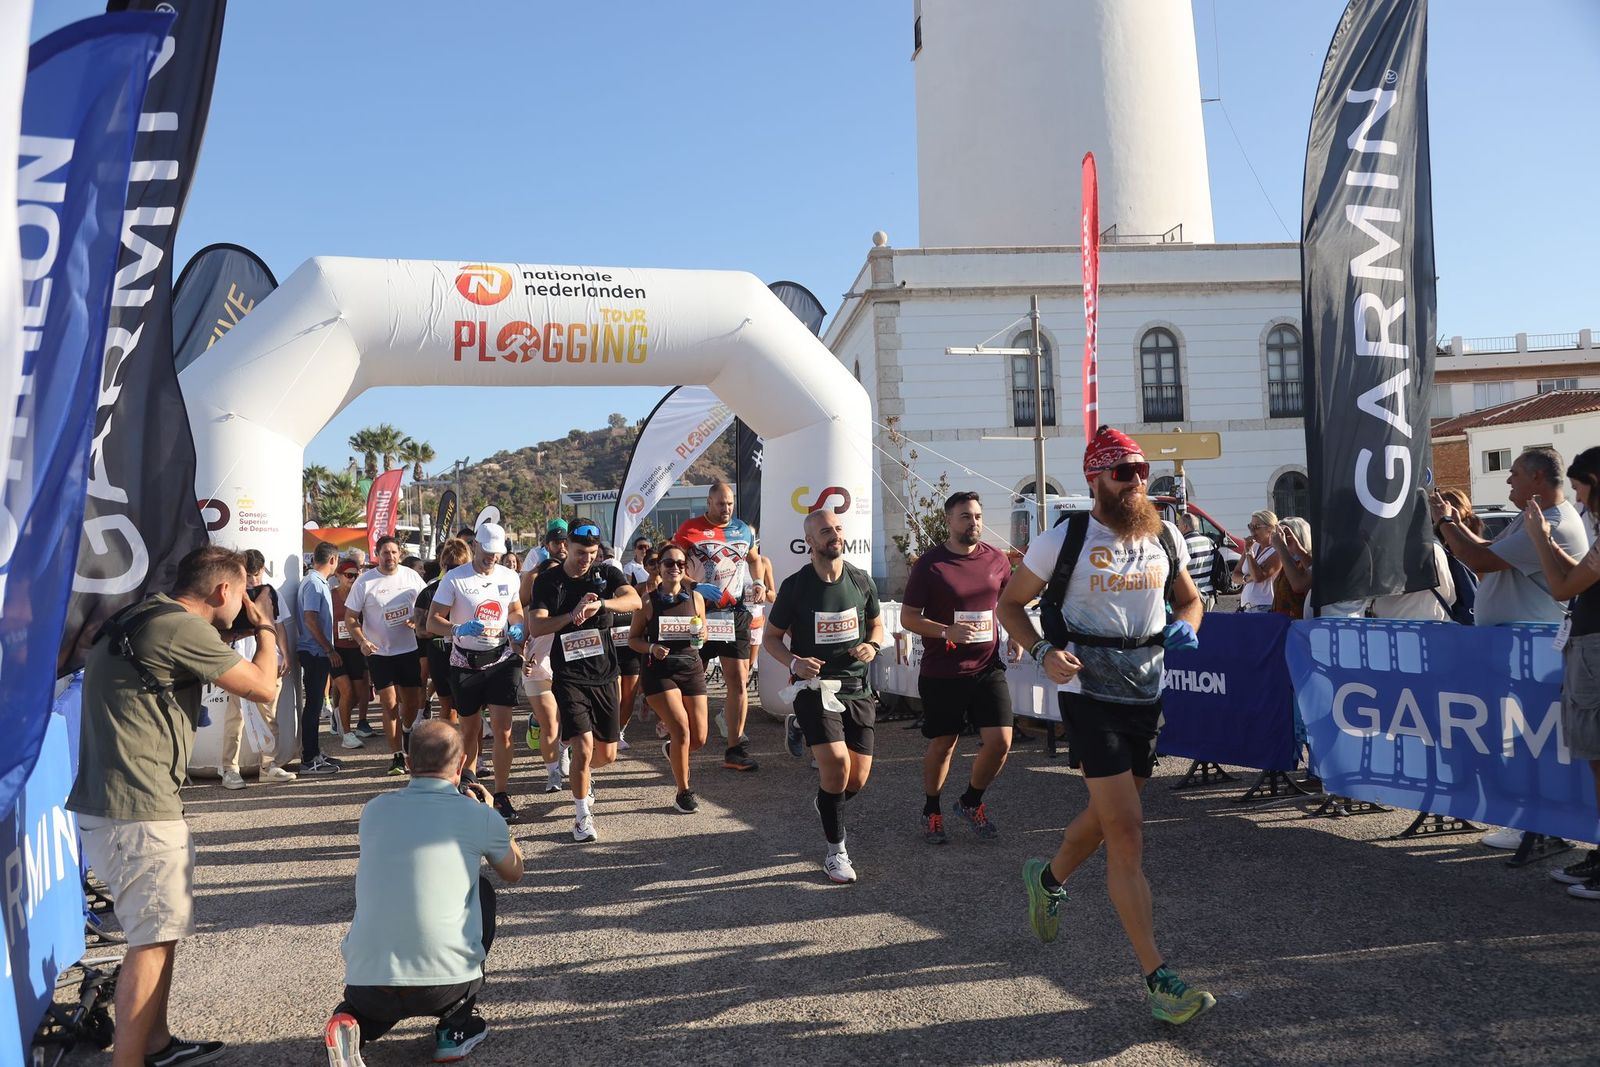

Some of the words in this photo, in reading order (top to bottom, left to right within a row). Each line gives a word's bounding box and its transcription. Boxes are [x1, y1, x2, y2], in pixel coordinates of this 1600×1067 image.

[523, 270, 612, 283] nationale
[525, 283, 646, 299] nederlanden
[1345, 86, 1412, 520] GARMIN
[600, 307, 647, 323] TOUR
[639, 465, 663, 493] nationale
[645, 461, 676, 497] nederlanden
[789, 538, 871, 555] GMIN
[479, 607, 500, 617] PONLE
[707, 625, 732, 633] 24392
[819, 619, 855, 633] 24380
[566, 637, 597, 651] 24937
